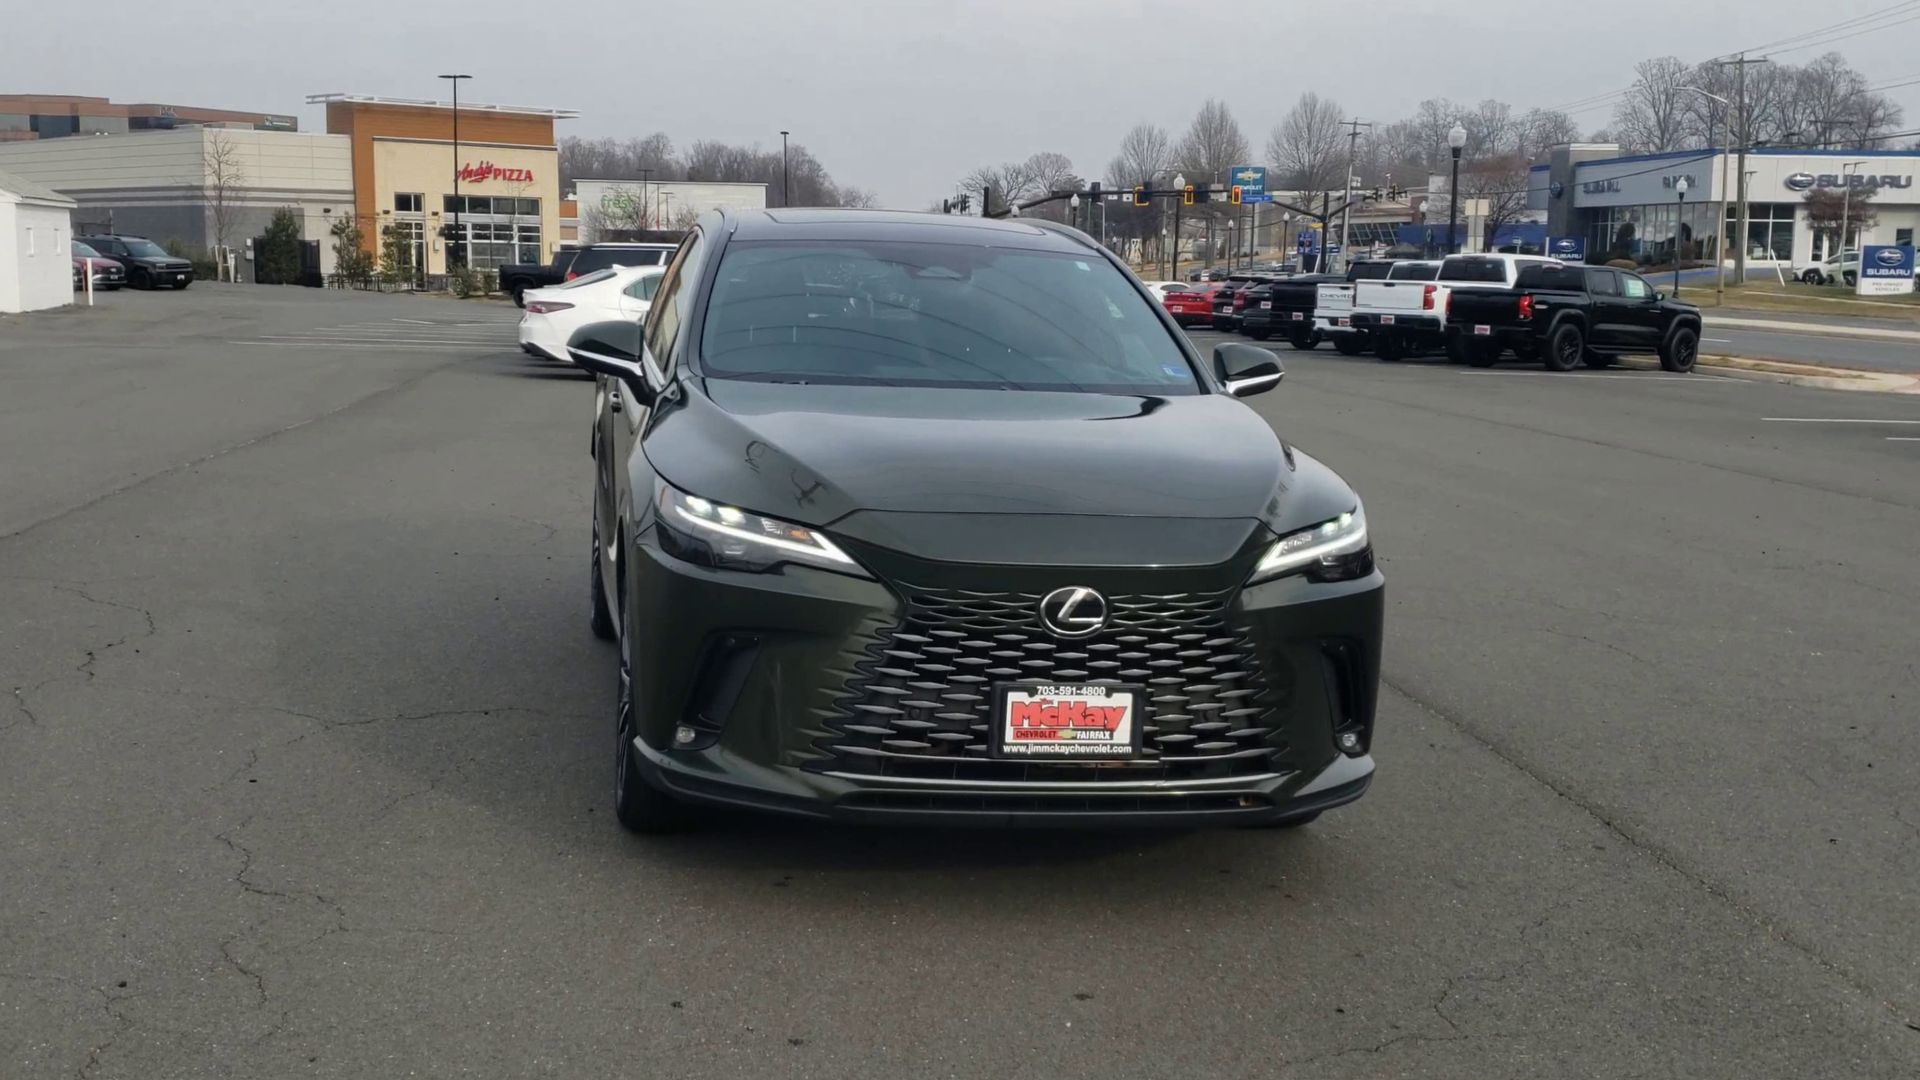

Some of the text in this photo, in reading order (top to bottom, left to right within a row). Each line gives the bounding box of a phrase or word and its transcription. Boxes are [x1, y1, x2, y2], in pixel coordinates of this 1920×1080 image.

[493, 167, 533, 182] PIZZA
[1816, 174, 1912, 189] SUBARU
[1866, 268, 1910, 276] SUBARU
[1037, 686, 1106, 696] 703-591-4800
[1010, 701, 1128, 732] McKay
[1076, 732, 1111, 740] FAIRFAX
[1003, 744, 1132, 755] www.jimmckaychevrolet.com
